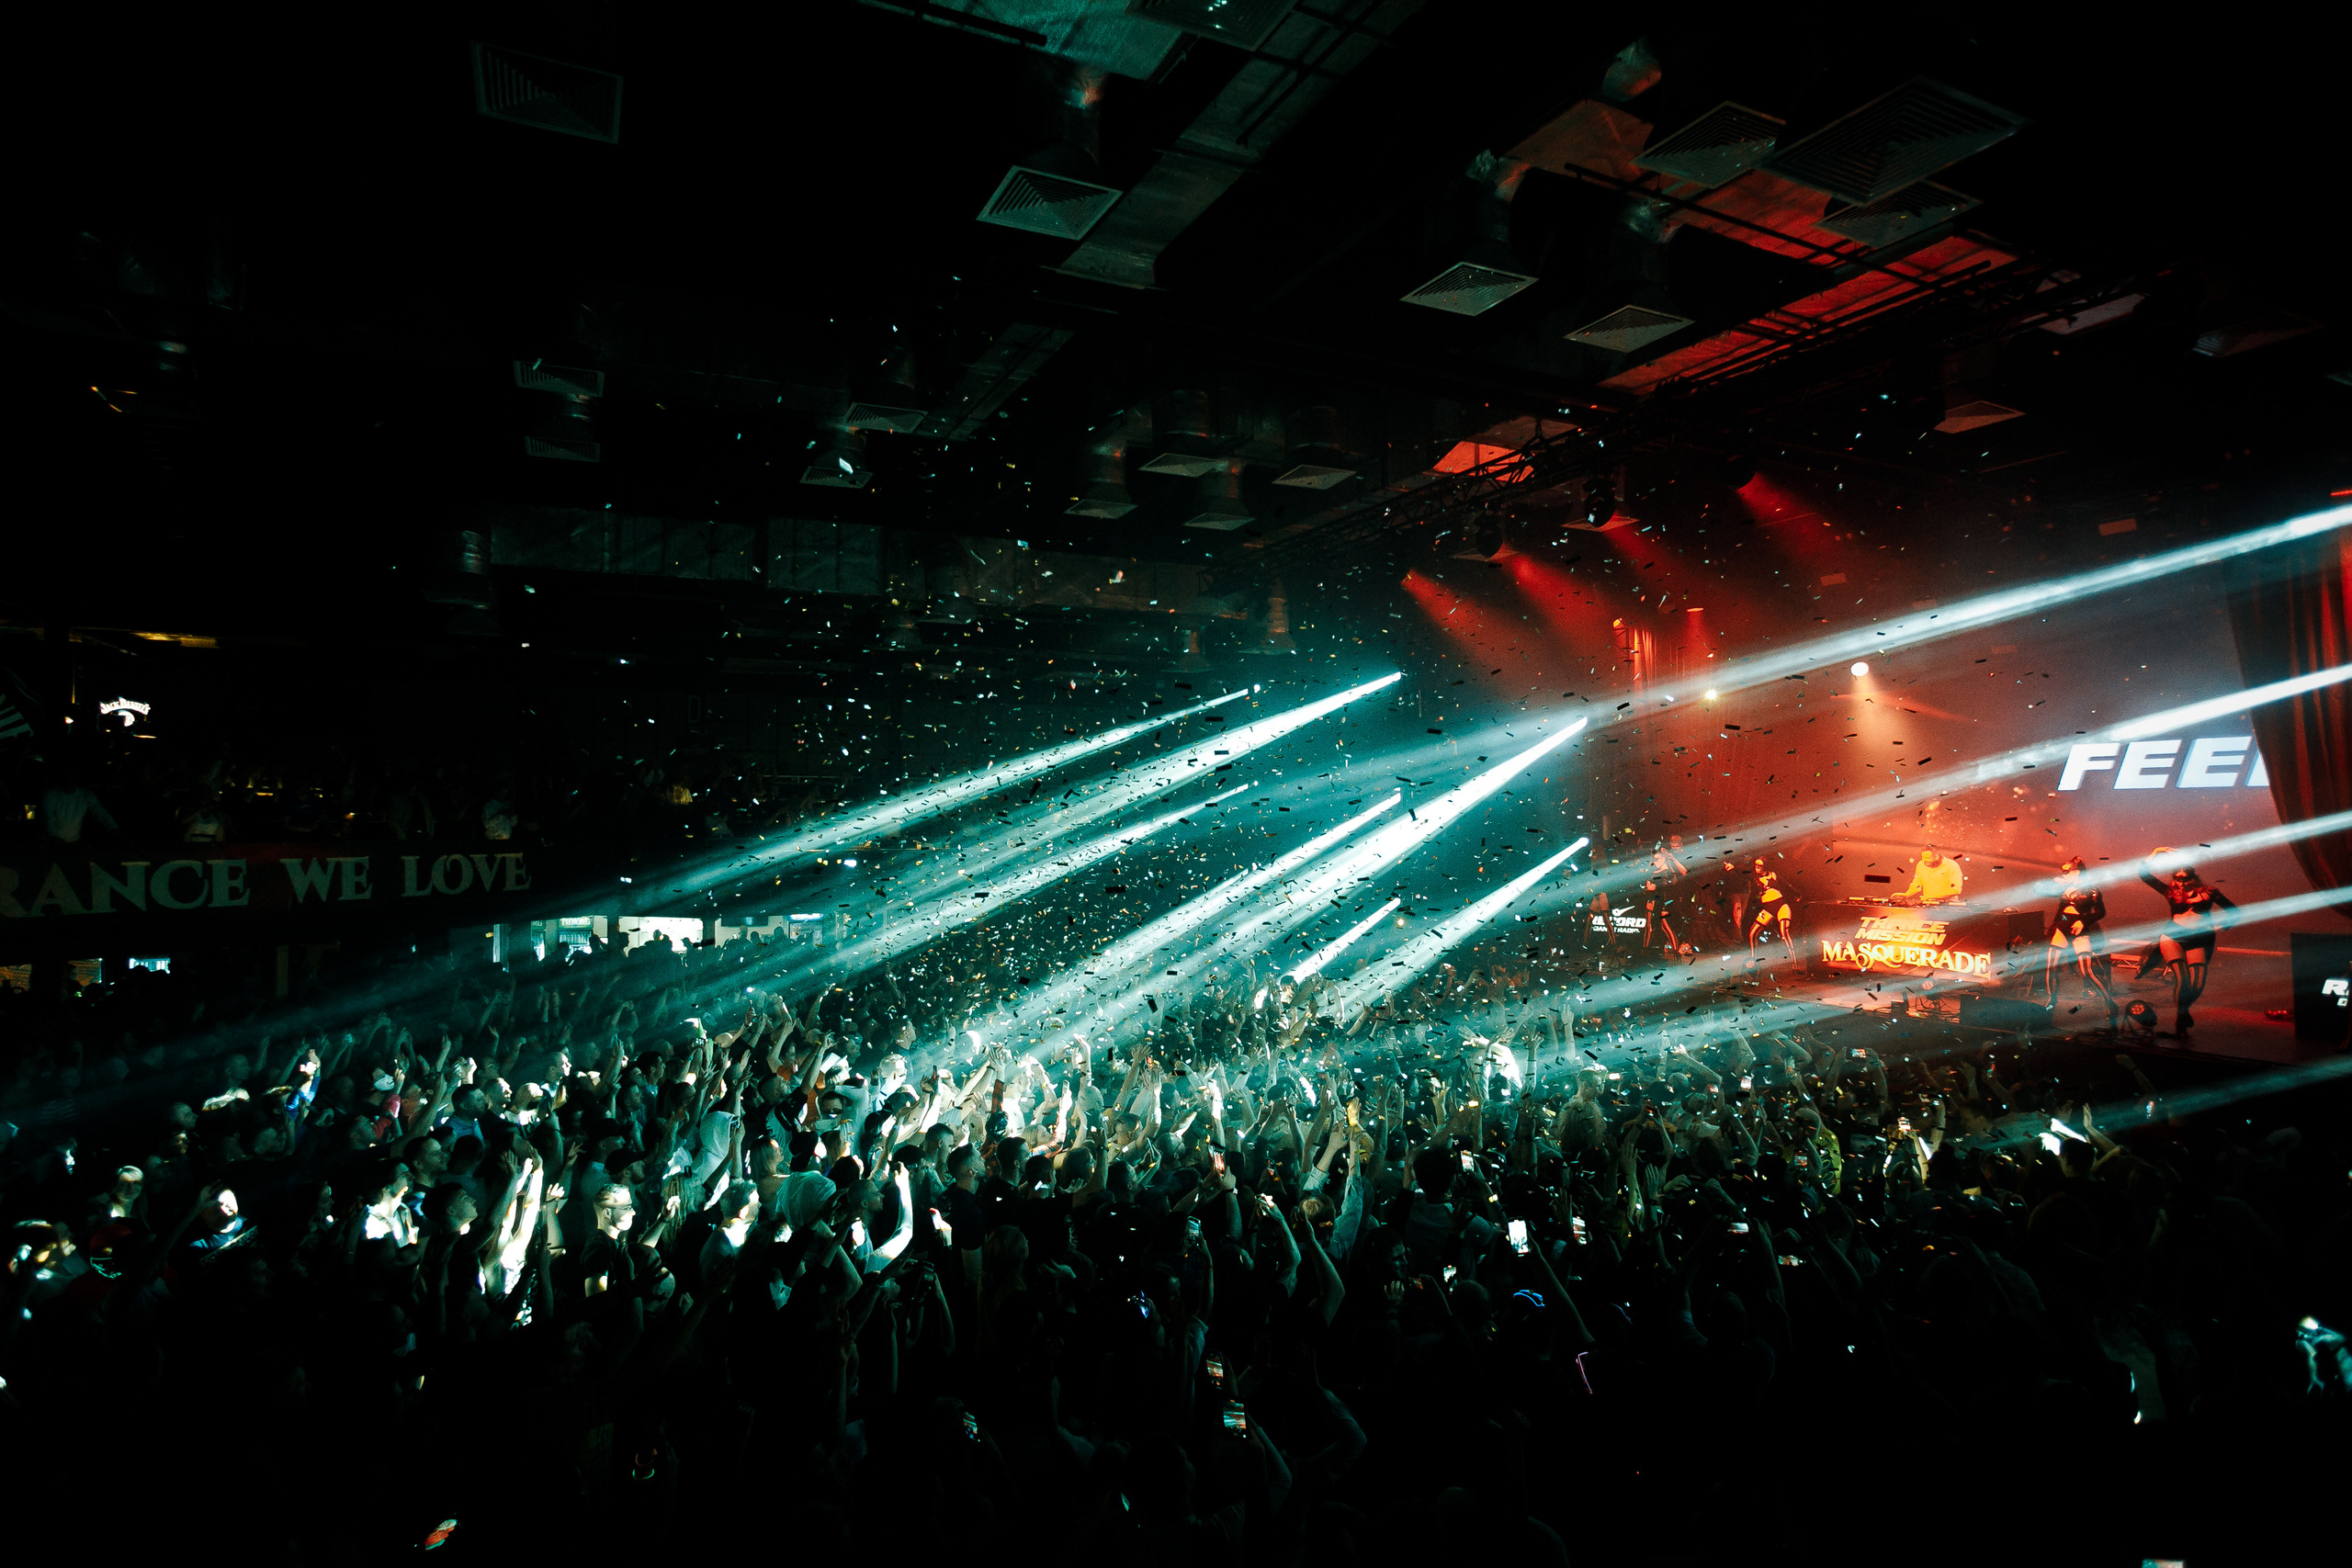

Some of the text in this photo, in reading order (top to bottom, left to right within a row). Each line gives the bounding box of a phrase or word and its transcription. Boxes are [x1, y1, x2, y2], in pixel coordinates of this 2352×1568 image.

[279, 855, 373, 904] WE
[401, 852, 532, 897] LOVE
[560, 917, 591, 926] TUBORG
[1860, 917, 1950, 932] TRANCE
[1855, 929, 1947, 945] MISSION
[1822, 941, 1991, 980] MASQUERADE
